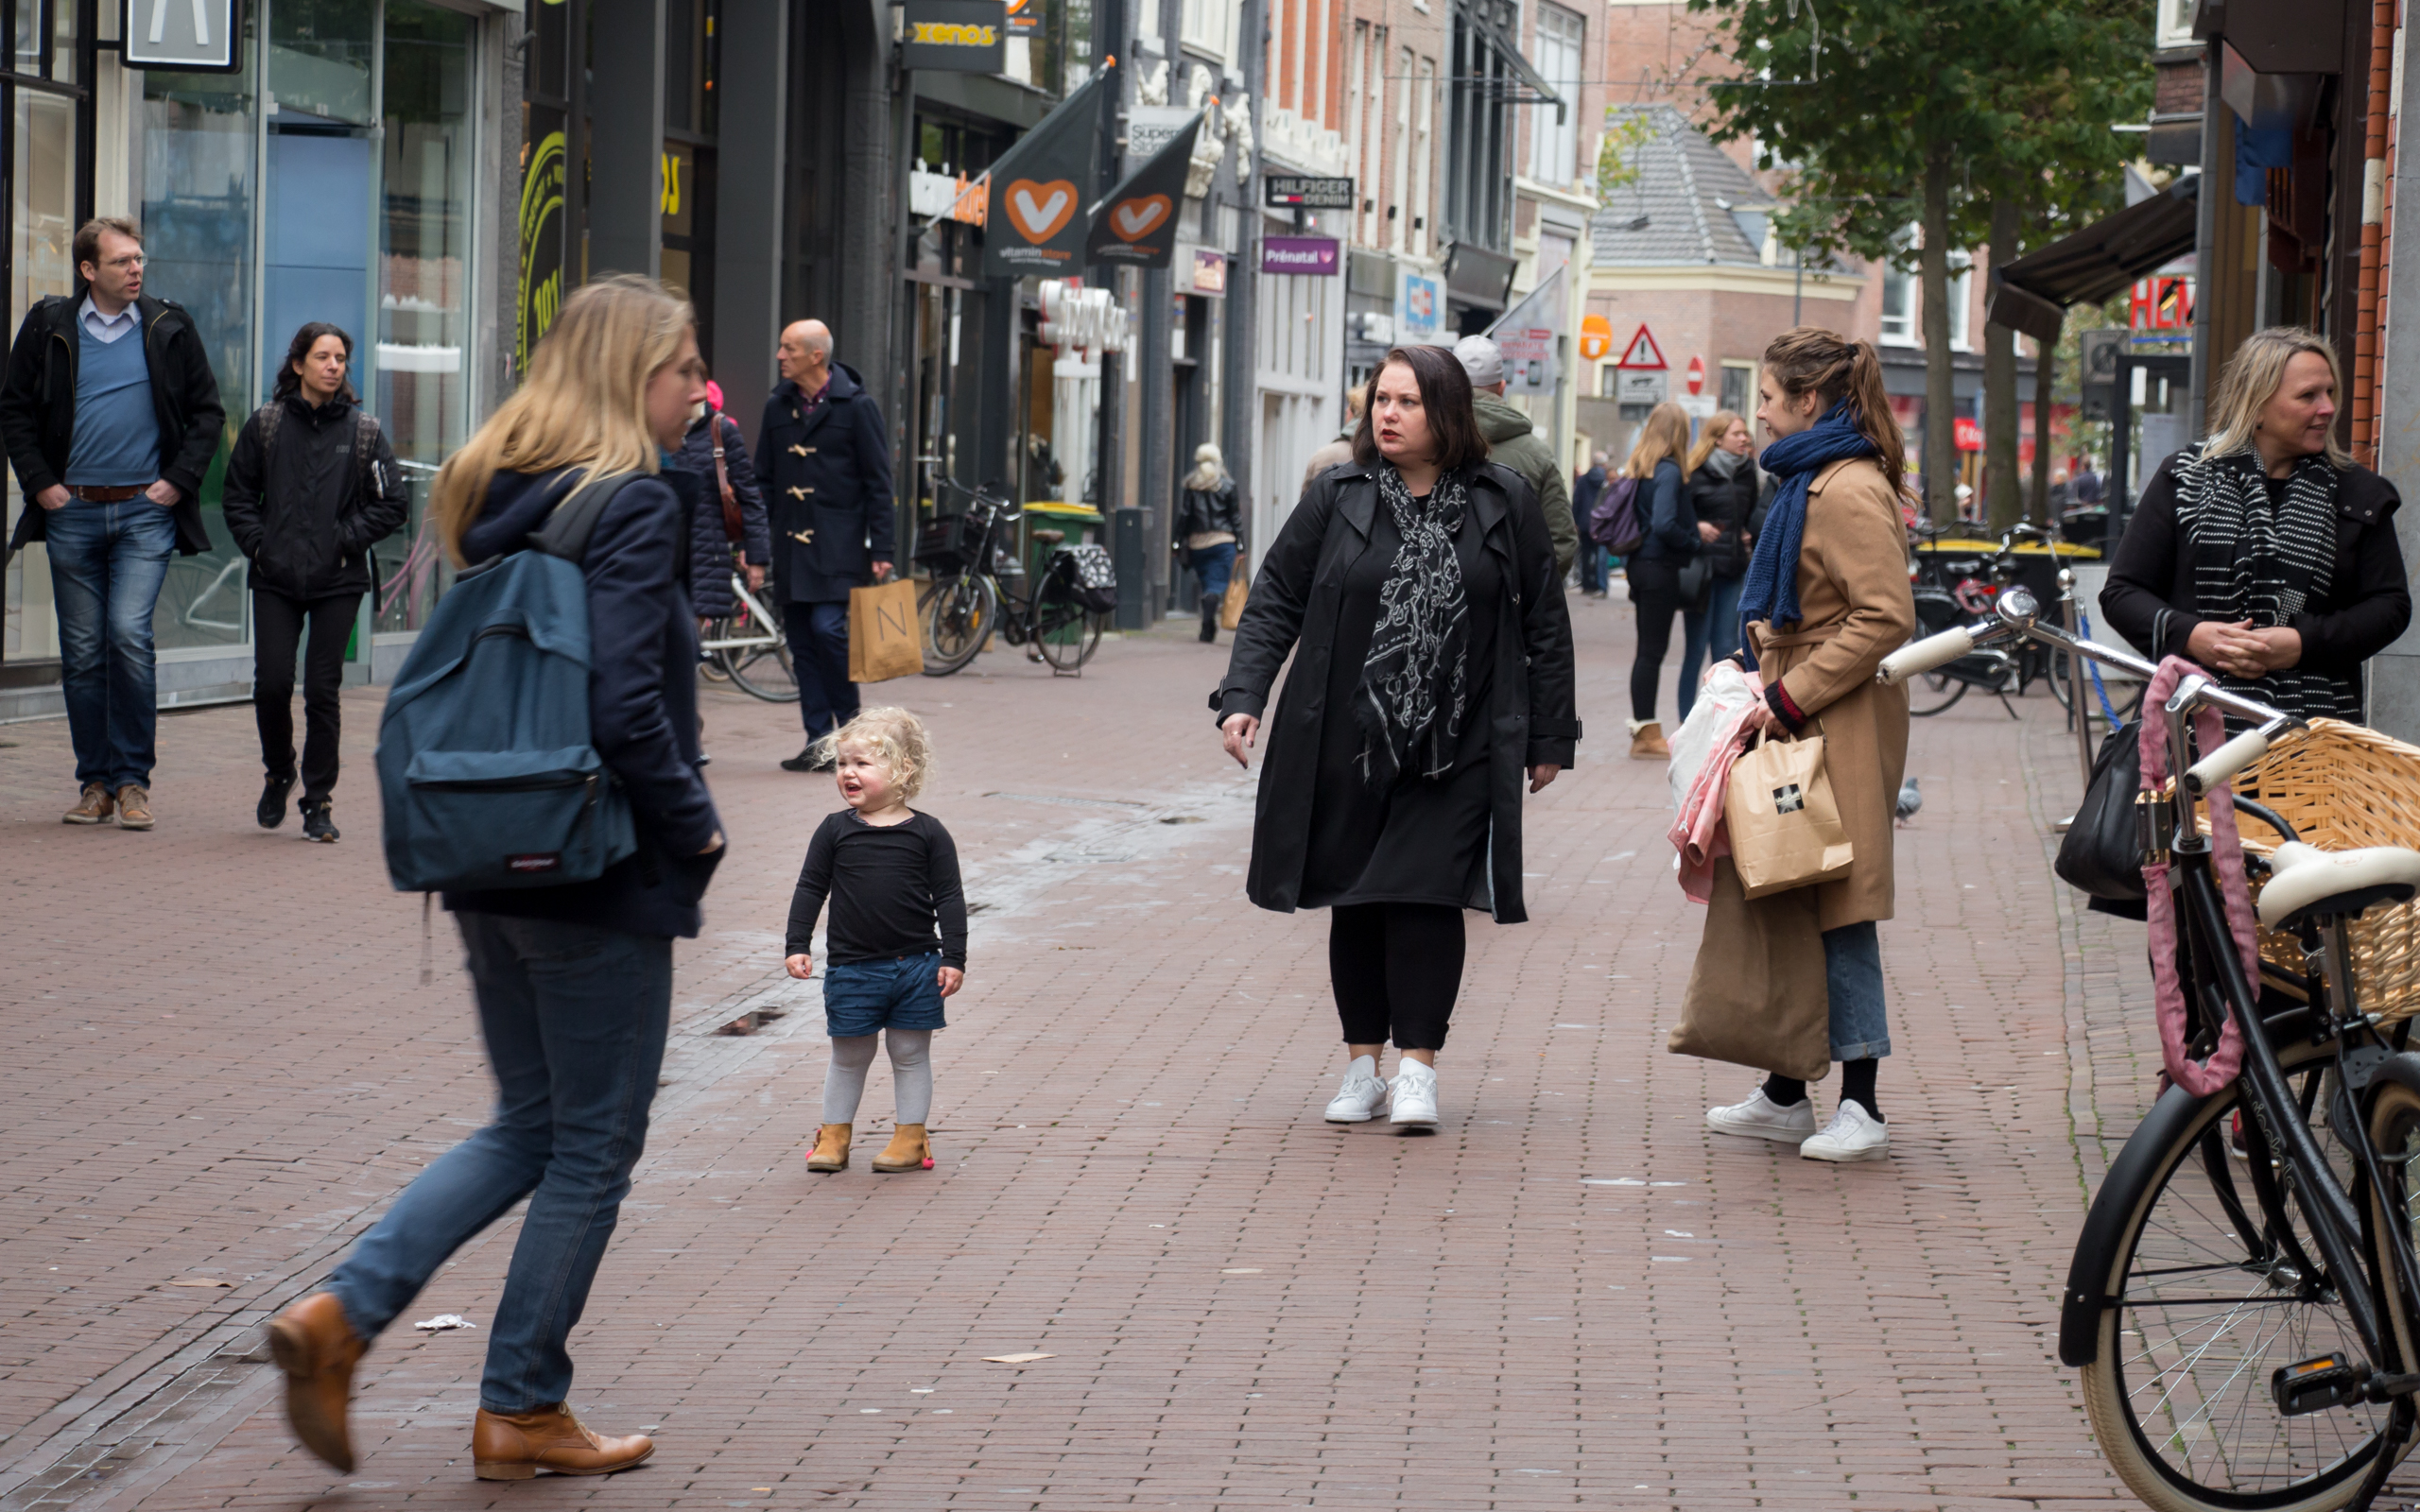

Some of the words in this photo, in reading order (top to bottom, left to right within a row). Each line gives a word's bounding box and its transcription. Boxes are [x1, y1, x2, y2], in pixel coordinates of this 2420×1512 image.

[912, 22, 996, 46] xenos
[1271, 179, 1350, 195] HILFIGER
[1305, 195, 1350, 206] DENIM
[1265, 249, 1319, 264] Prénatal
[877, 601, 908, 642] N
